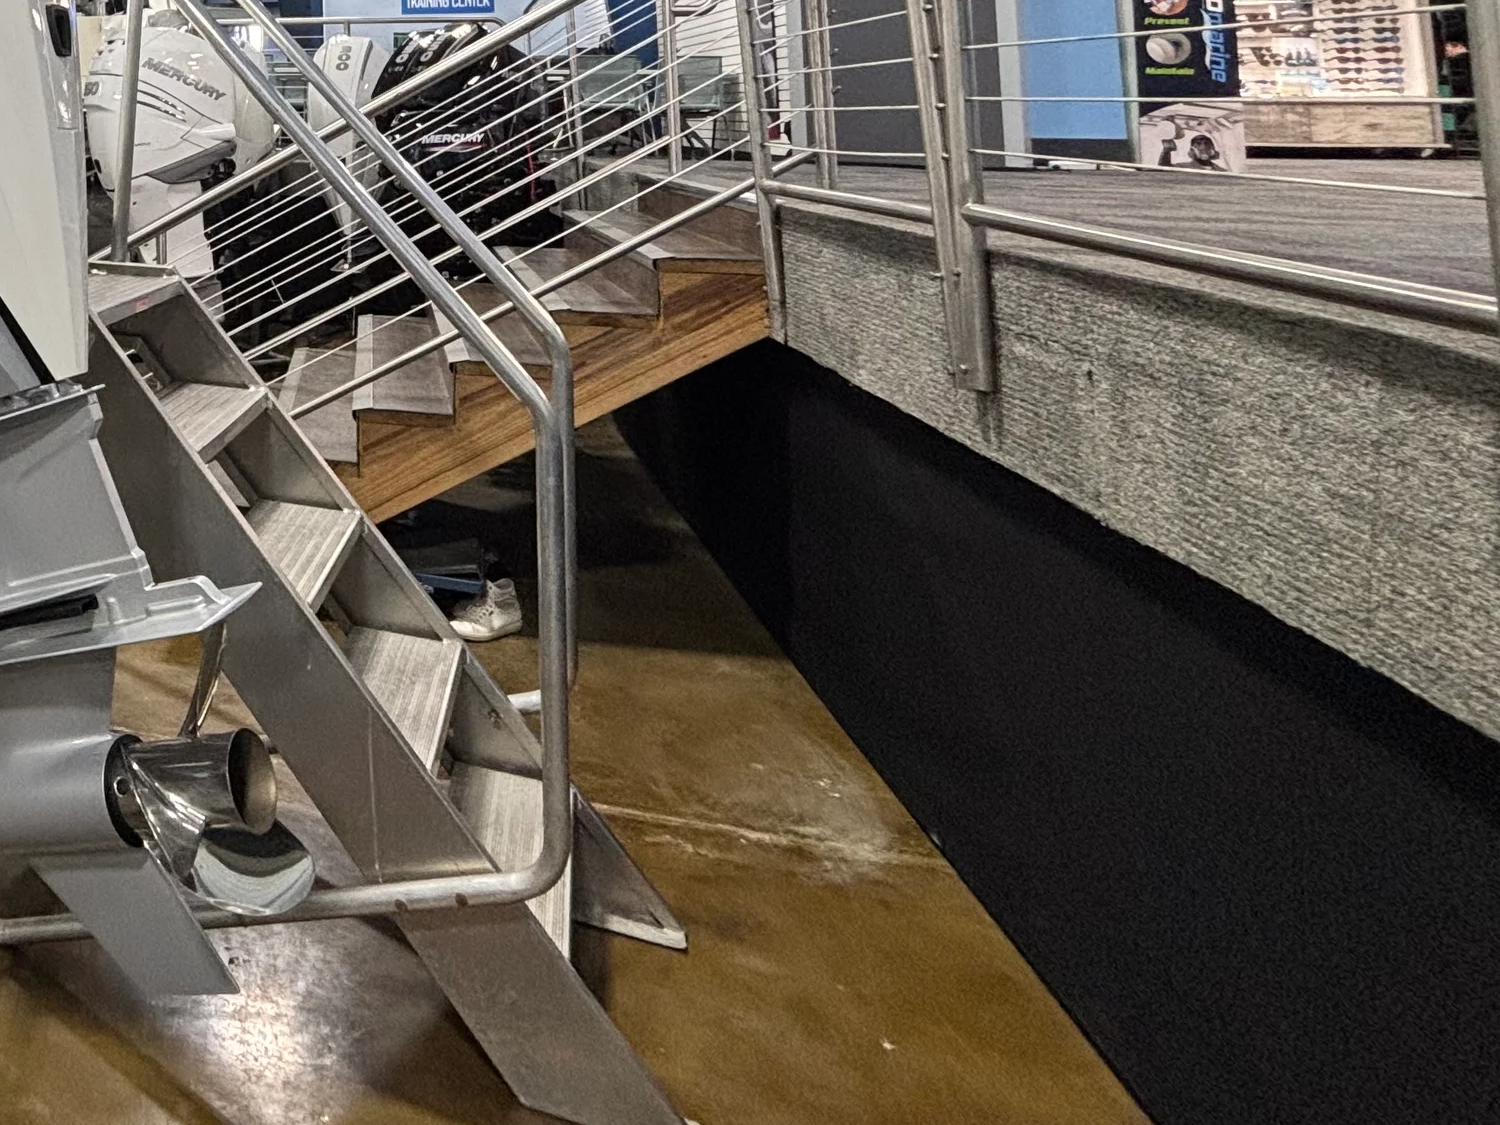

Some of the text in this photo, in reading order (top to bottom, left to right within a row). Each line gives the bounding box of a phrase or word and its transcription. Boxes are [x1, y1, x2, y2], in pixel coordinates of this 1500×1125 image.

[1144, 17, 1190, 25] Prevent
[141, 57, 226, 101] MERCURY
[421, 133, 485, 145] MERCURY
